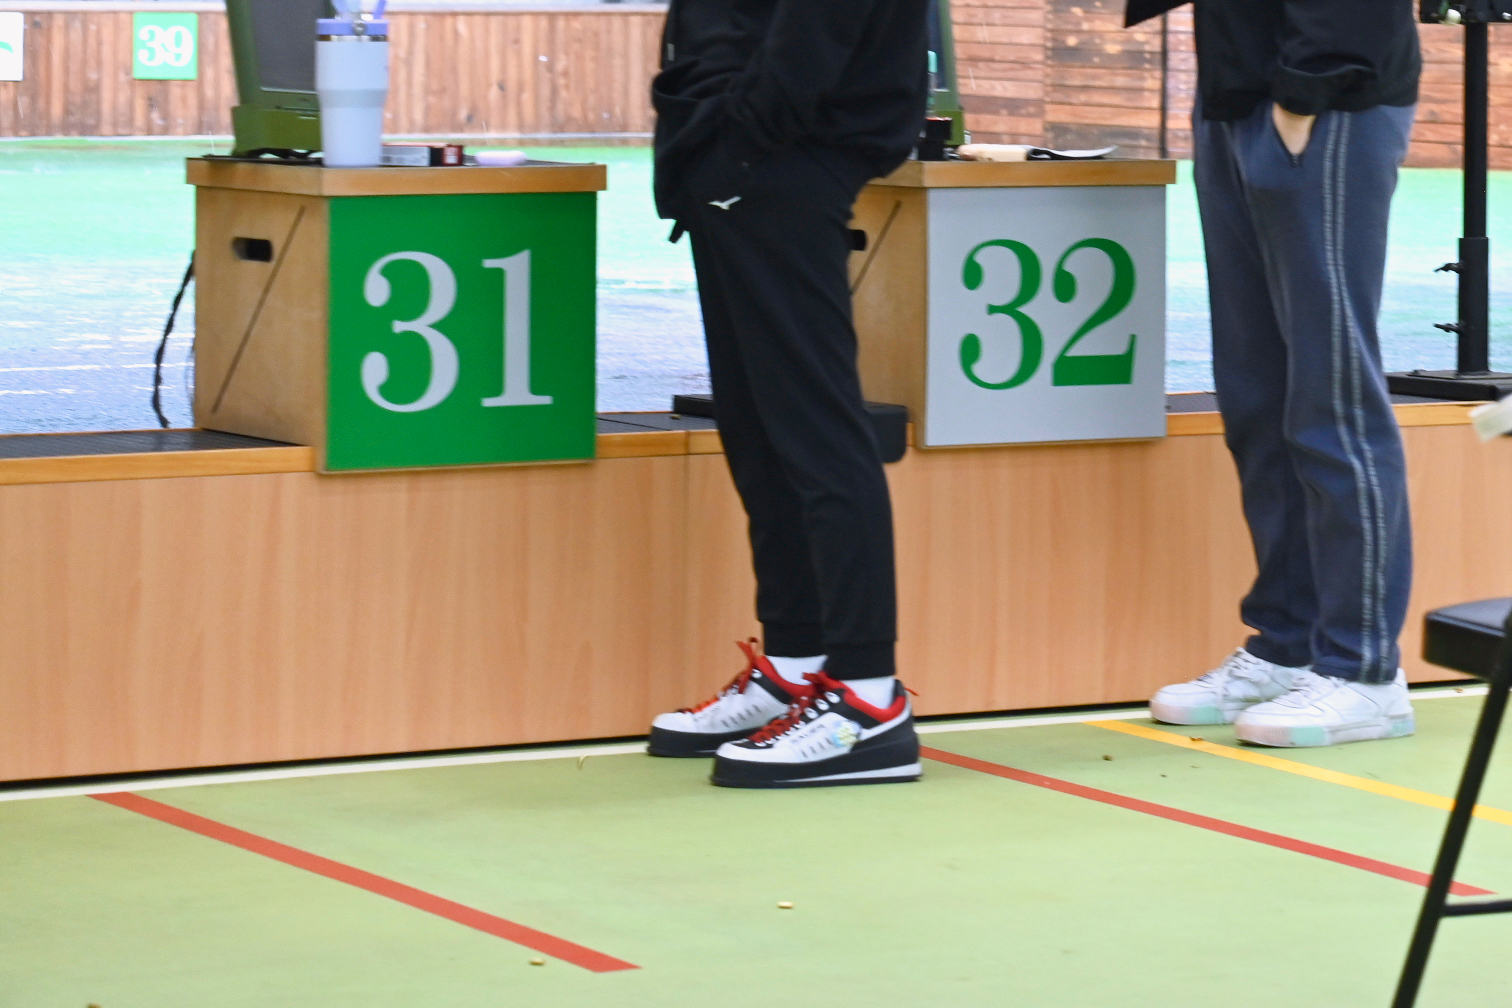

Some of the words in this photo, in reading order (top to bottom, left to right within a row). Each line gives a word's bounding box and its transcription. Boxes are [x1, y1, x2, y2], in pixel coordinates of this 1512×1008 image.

[138, 25, 193, 67] 39
[360, 248, 554, 413] 31
[958, 237, 1137, 391] 32
